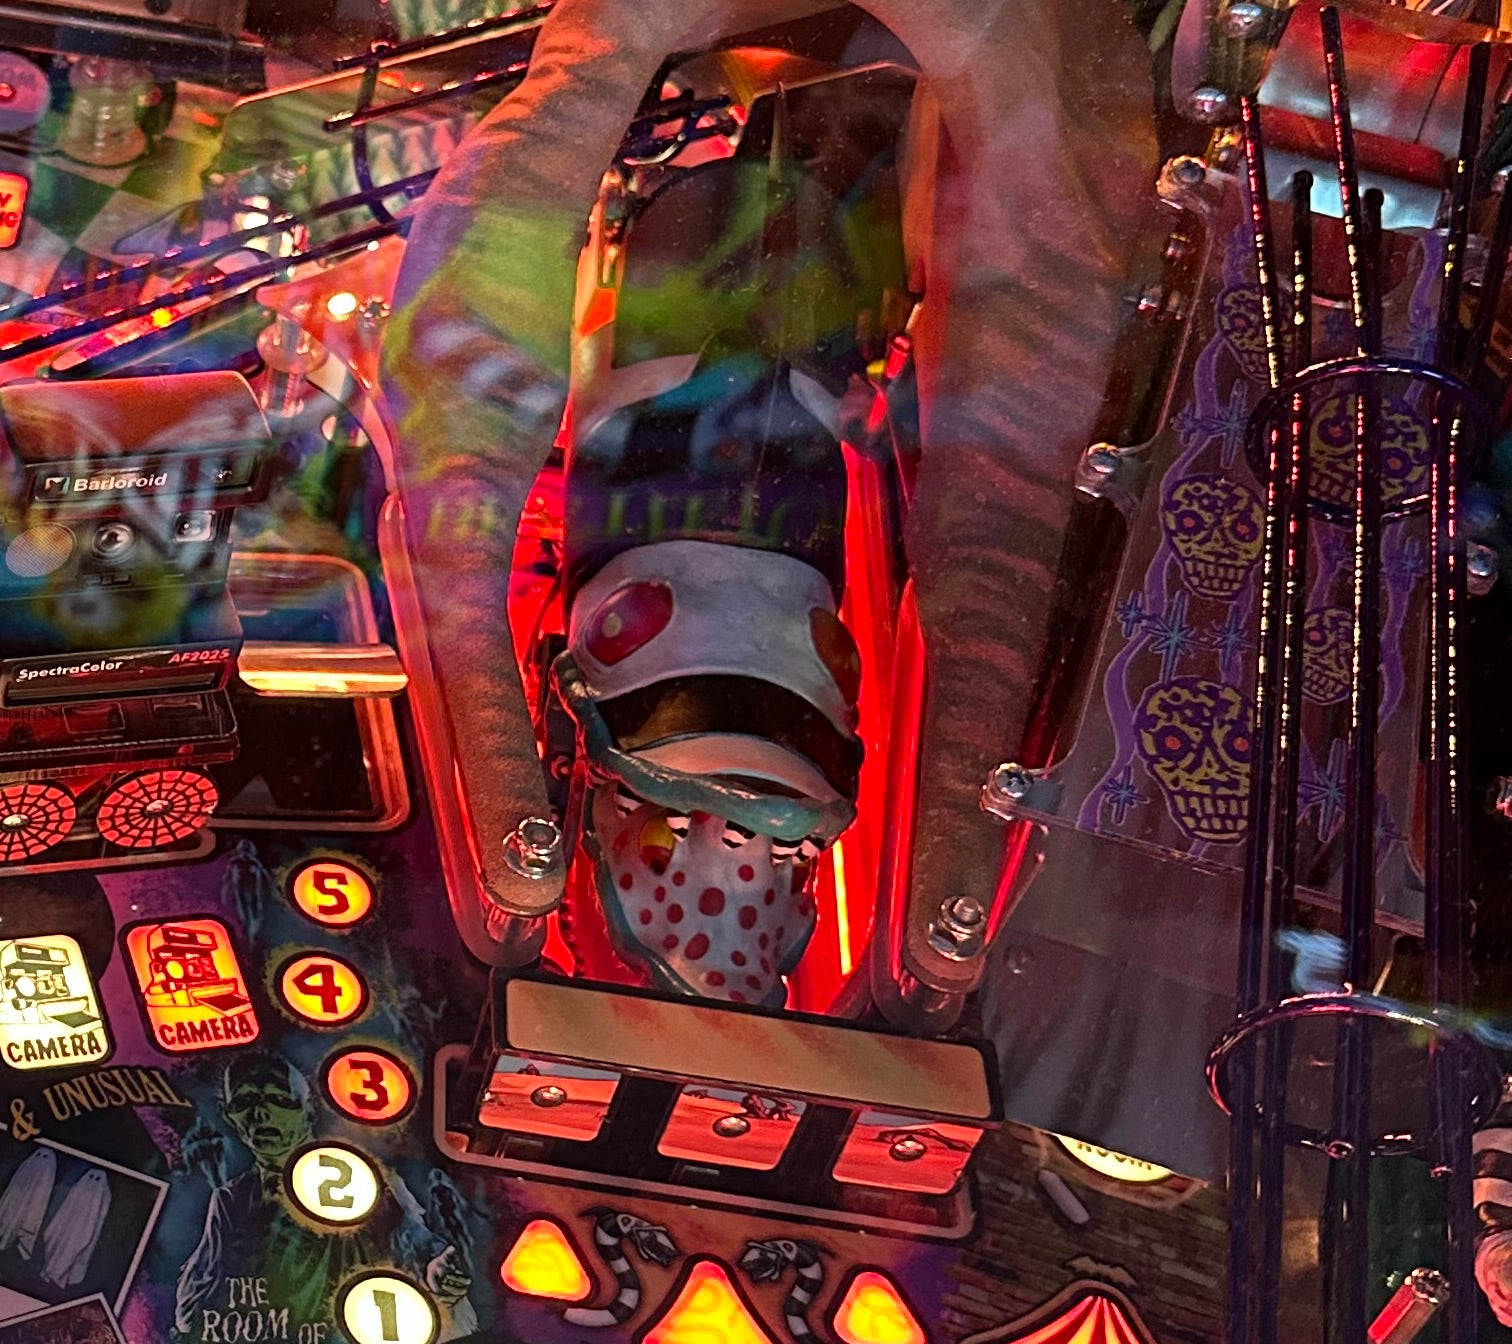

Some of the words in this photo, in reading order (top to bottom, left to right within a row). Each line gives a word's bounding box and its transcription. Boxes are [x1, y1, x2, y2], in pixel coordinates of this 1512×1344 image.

[18, 660, 124, 681] SpectraColor
[168, 648, 232, 665] AF2025
[313, 871, 348, 917] 5
[298, 964, 344, 1015] 4
[7, 1032, 103, 1063] CAMERA
[158, 1015, 255, 1047] CAMERA
[9, 1098, 42, 1142] &
[42, 1067, 193, 1123] UNUSUAL
[349, 1059, 391, 1113] 3
[318, 1153, 354, 1210] 2
[225, 1276, 271, 1309] THE
[200, 1304, 290, 1344] ROOM
[371, 1289, 400, 1343] 1
